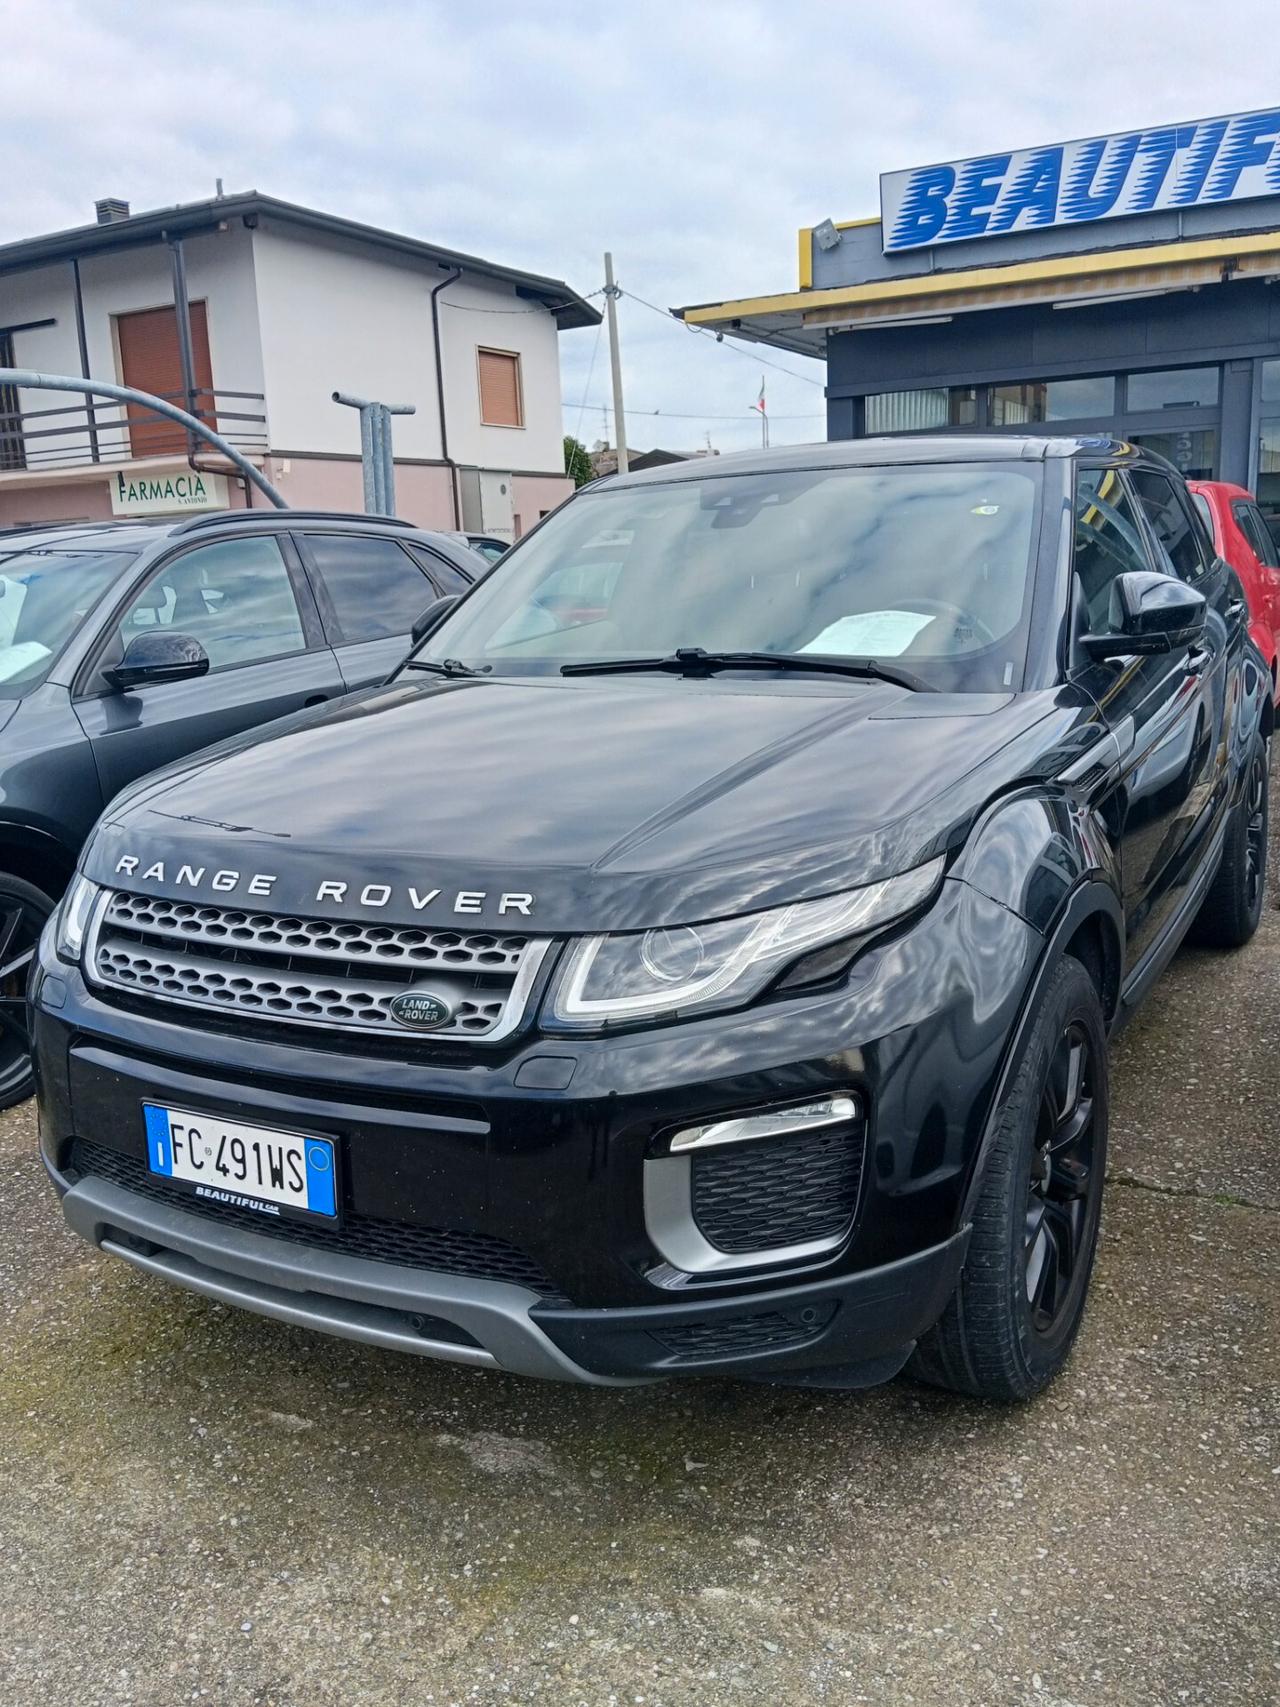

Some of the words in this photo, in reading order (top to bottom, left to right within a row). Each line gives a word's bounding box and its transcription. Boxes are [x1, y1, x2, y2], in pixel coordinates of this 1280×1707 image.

[887, 111, 1280, 248] BEAUTIF
[115, 854, 277, 896] RANGE
[315, 880, 537, 916] ROVER
[195, 1186, 267, 1213] BEAUTIFUL
